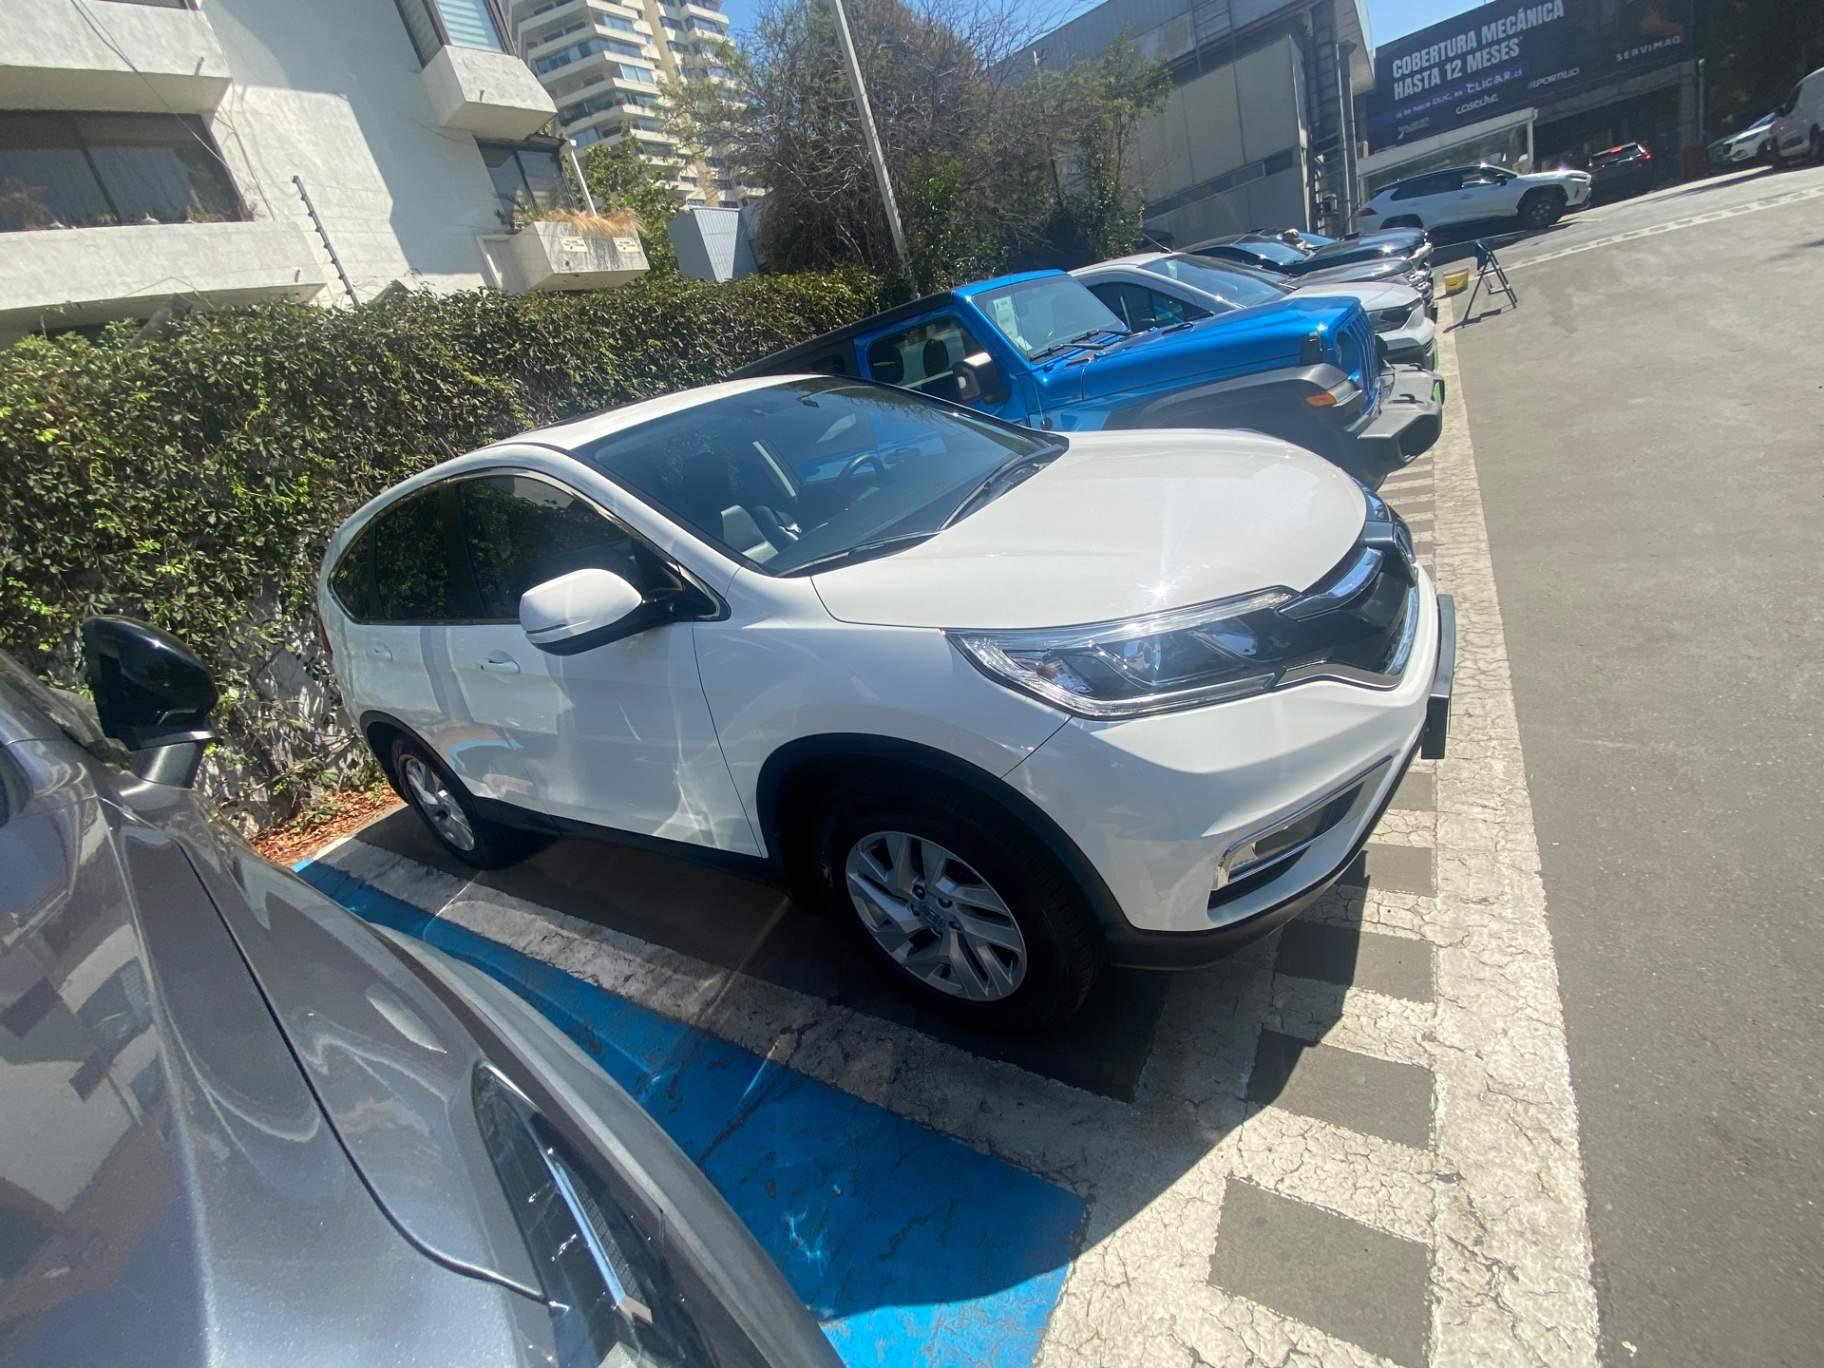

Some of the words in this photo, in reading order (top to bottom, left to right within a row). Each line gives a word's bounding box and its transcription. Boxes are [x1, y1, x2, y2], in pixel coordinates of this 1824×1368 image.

[1392, 30, 1477, 78] COBERTURA
[1481, 0, 1564, 45] MECÁNICA
[1394, 67, 1441, 100] HASTA
[1445, 59, 1463, 80] 12
